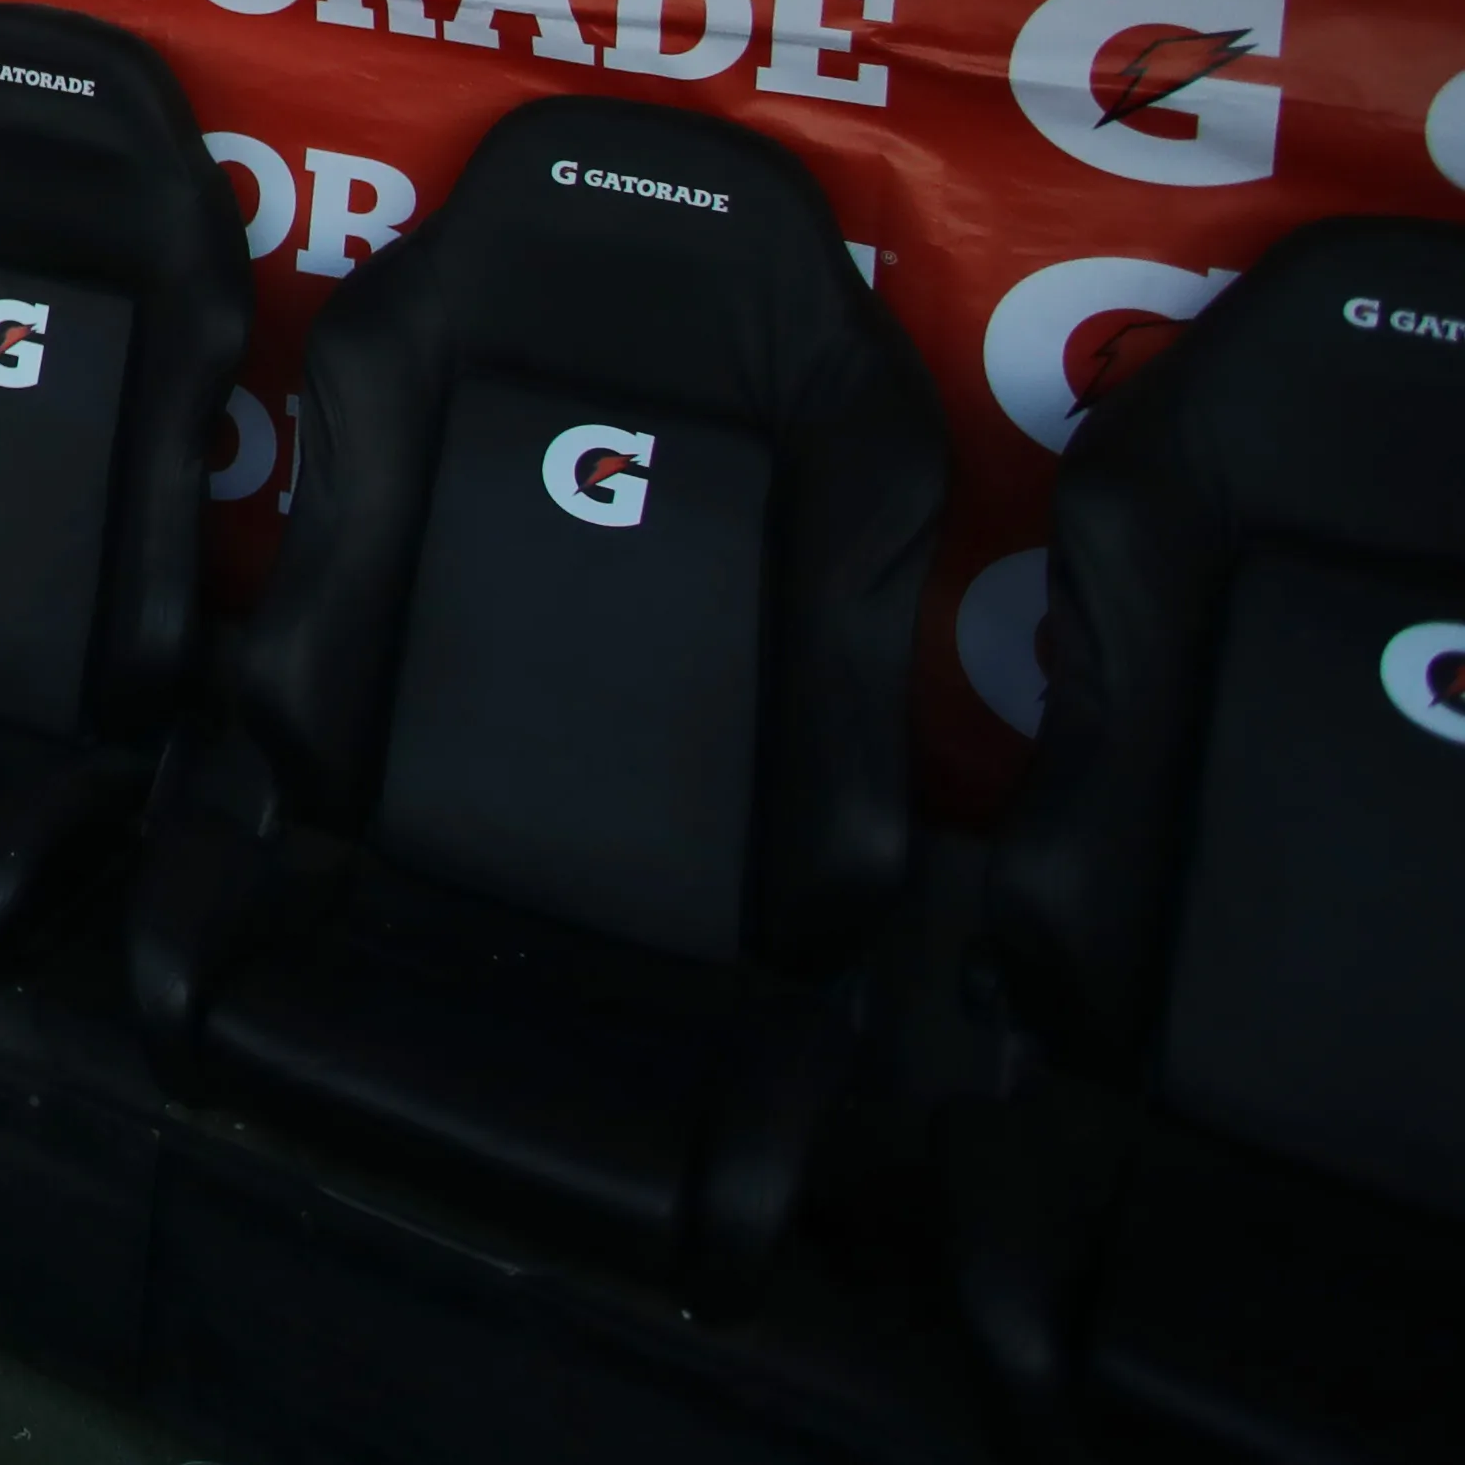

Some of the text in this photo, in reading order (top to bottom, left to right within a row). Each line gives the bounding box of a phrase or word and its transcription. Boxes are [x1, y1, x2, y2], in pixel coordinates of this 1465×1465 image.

[551, 160, 730, 214] G GATORADE
[1343, 298, 1465, 342] G GAT
[542, 424, 655, 528] G
